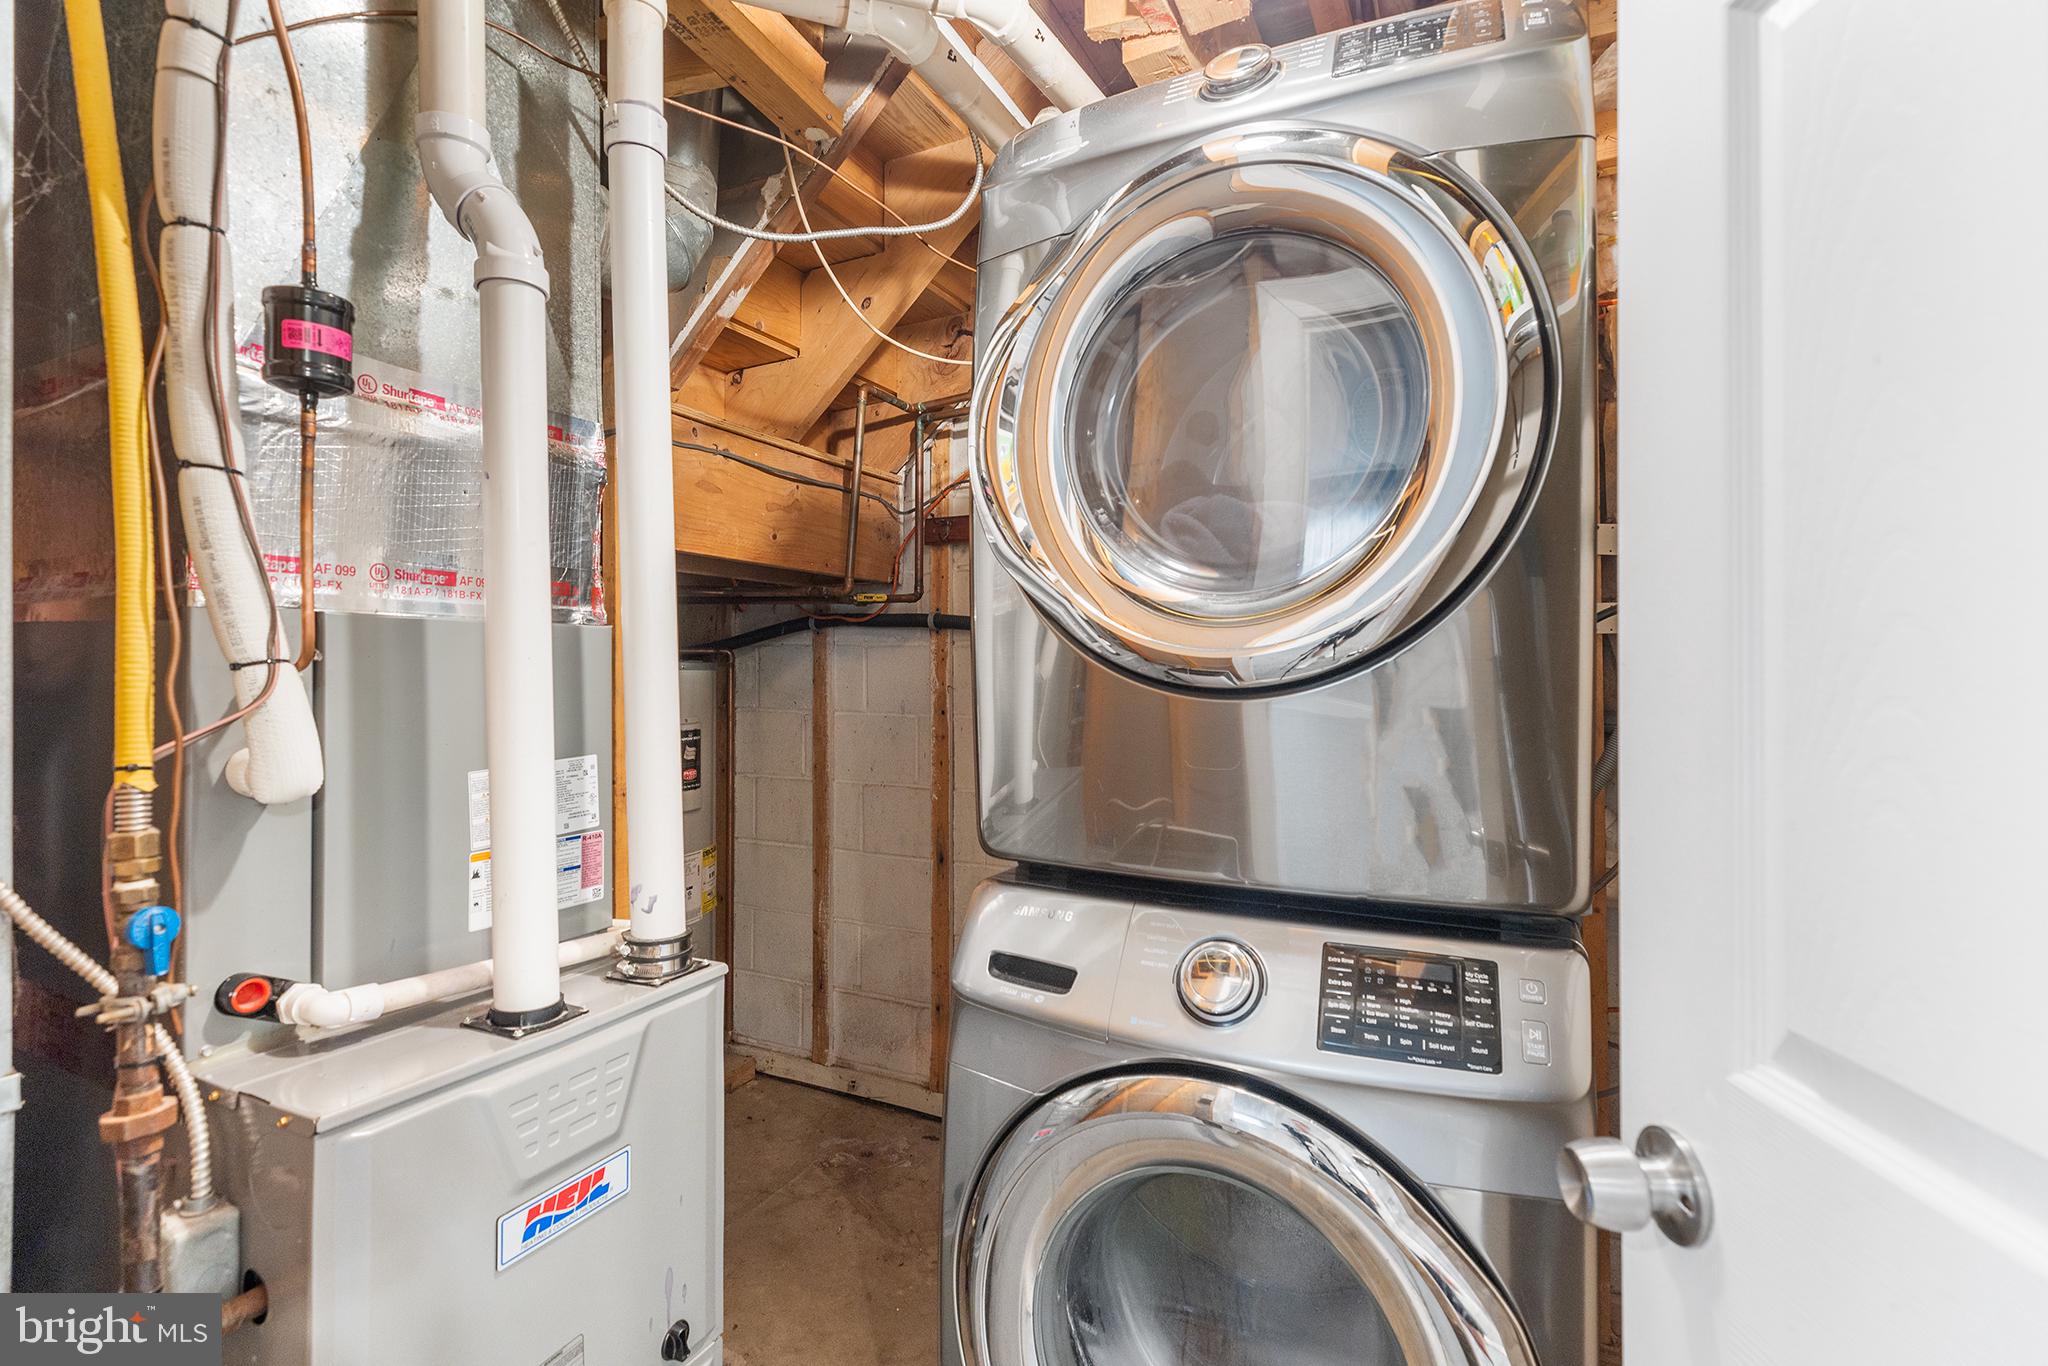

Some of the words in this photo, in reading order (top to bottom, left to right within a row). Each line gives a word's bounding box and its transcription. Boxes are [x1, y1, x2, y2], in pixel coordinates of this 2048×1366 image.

[382, 384, 436, 408] Shurtape
[313, 563, 332, 574] AF
[335, 564, 356, 577] 099
[394, 568, 447, 584] Shurtape
[459, 576, 473, 586] AF
[396, 585, 432, 596] 181A-P
[443, 589, 482, 601] 181B-FX
[1013, 903, 1074, 922] SAMSUNG
[1474, 972, 1489, 980] Cycle
[1465, 995, 1481, 1004] Delay
[1481, 997, 1492, 1005] End
[1339, 1002, 1351, 1010] Only
[1399, 1006, 1420, 1014] Medium
[1435, 1011, 1451, 1019] Heavy
[1435, 1019, 1454, 1027] Normal
[1435, 1027, 1449, 1035] Light
[1399, 1038, 1413, 1046] Spin
[1428, 1041, 1440, 1049] Soil
[1440, 1043, 1456, 1052] Level
[1471, 1046, 1489, 1055] Sound
[522, 1165, 610, 1244] HEIL
